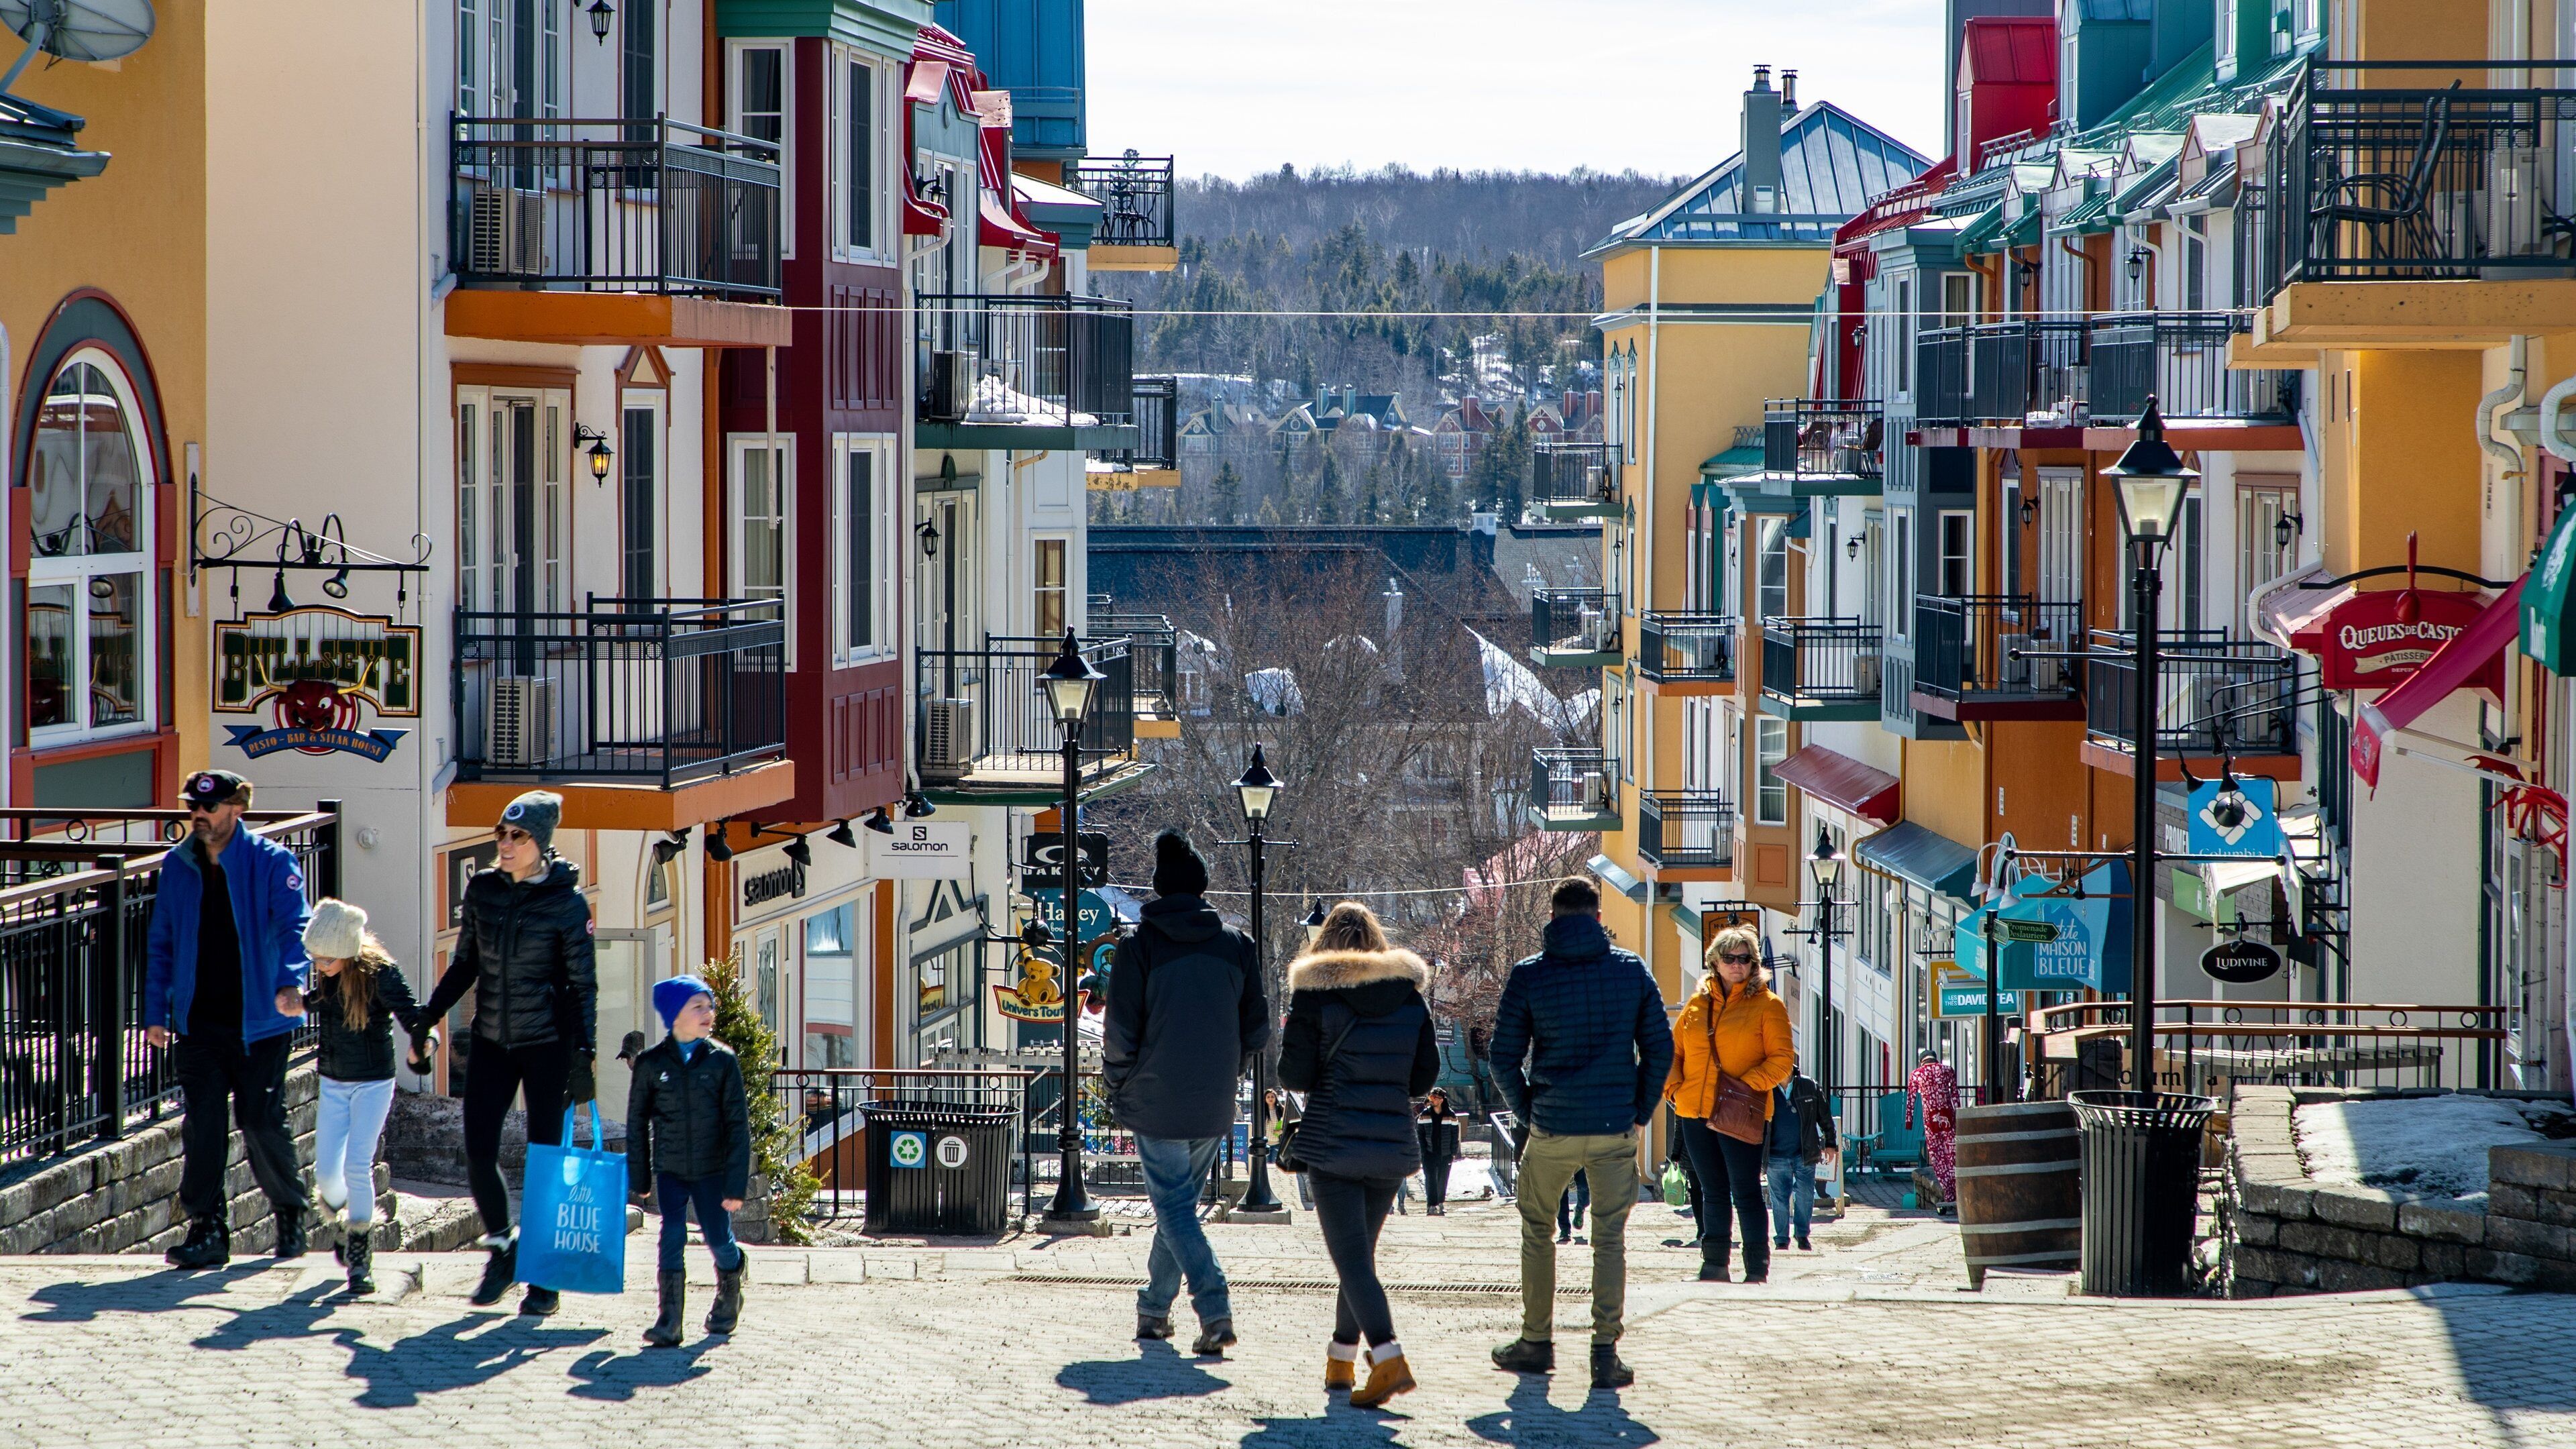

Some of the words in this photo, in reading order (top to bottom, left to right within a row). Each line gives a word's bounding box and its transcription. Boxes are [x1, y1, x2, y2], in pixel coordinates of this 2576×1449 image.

[2339, 625, 2406, 650] QUEUES
[2406, 625, 2417, 635] DE
[2417, 621, 2463, 641] CAST
[221, 631, 411, 708] BULLSEYE
[248, 737, 277, 753] RESTO
[286, 733, 306, 744] BAR
[309, 733, 317, 743] &
[319, 733, 350, 746] STEAK
[351, 738, 382, 757] HOUSE
[1022, 866, 1100, 875] OAKEY
[2006, 922, 2048, 932] Promenade
[2039, 941, 2087, 957] MAISON
[2039, 957, 2087, 976] BLEUE
[2215, 957, 2268, 970] LUDIVINE
[1002, 999, 1039, 1018] Univers
[566, 1183, 595, 1203] little
[557, 1203, 602, 1232] BLUE
[554, 1230, 601, 1253] HOUSE
